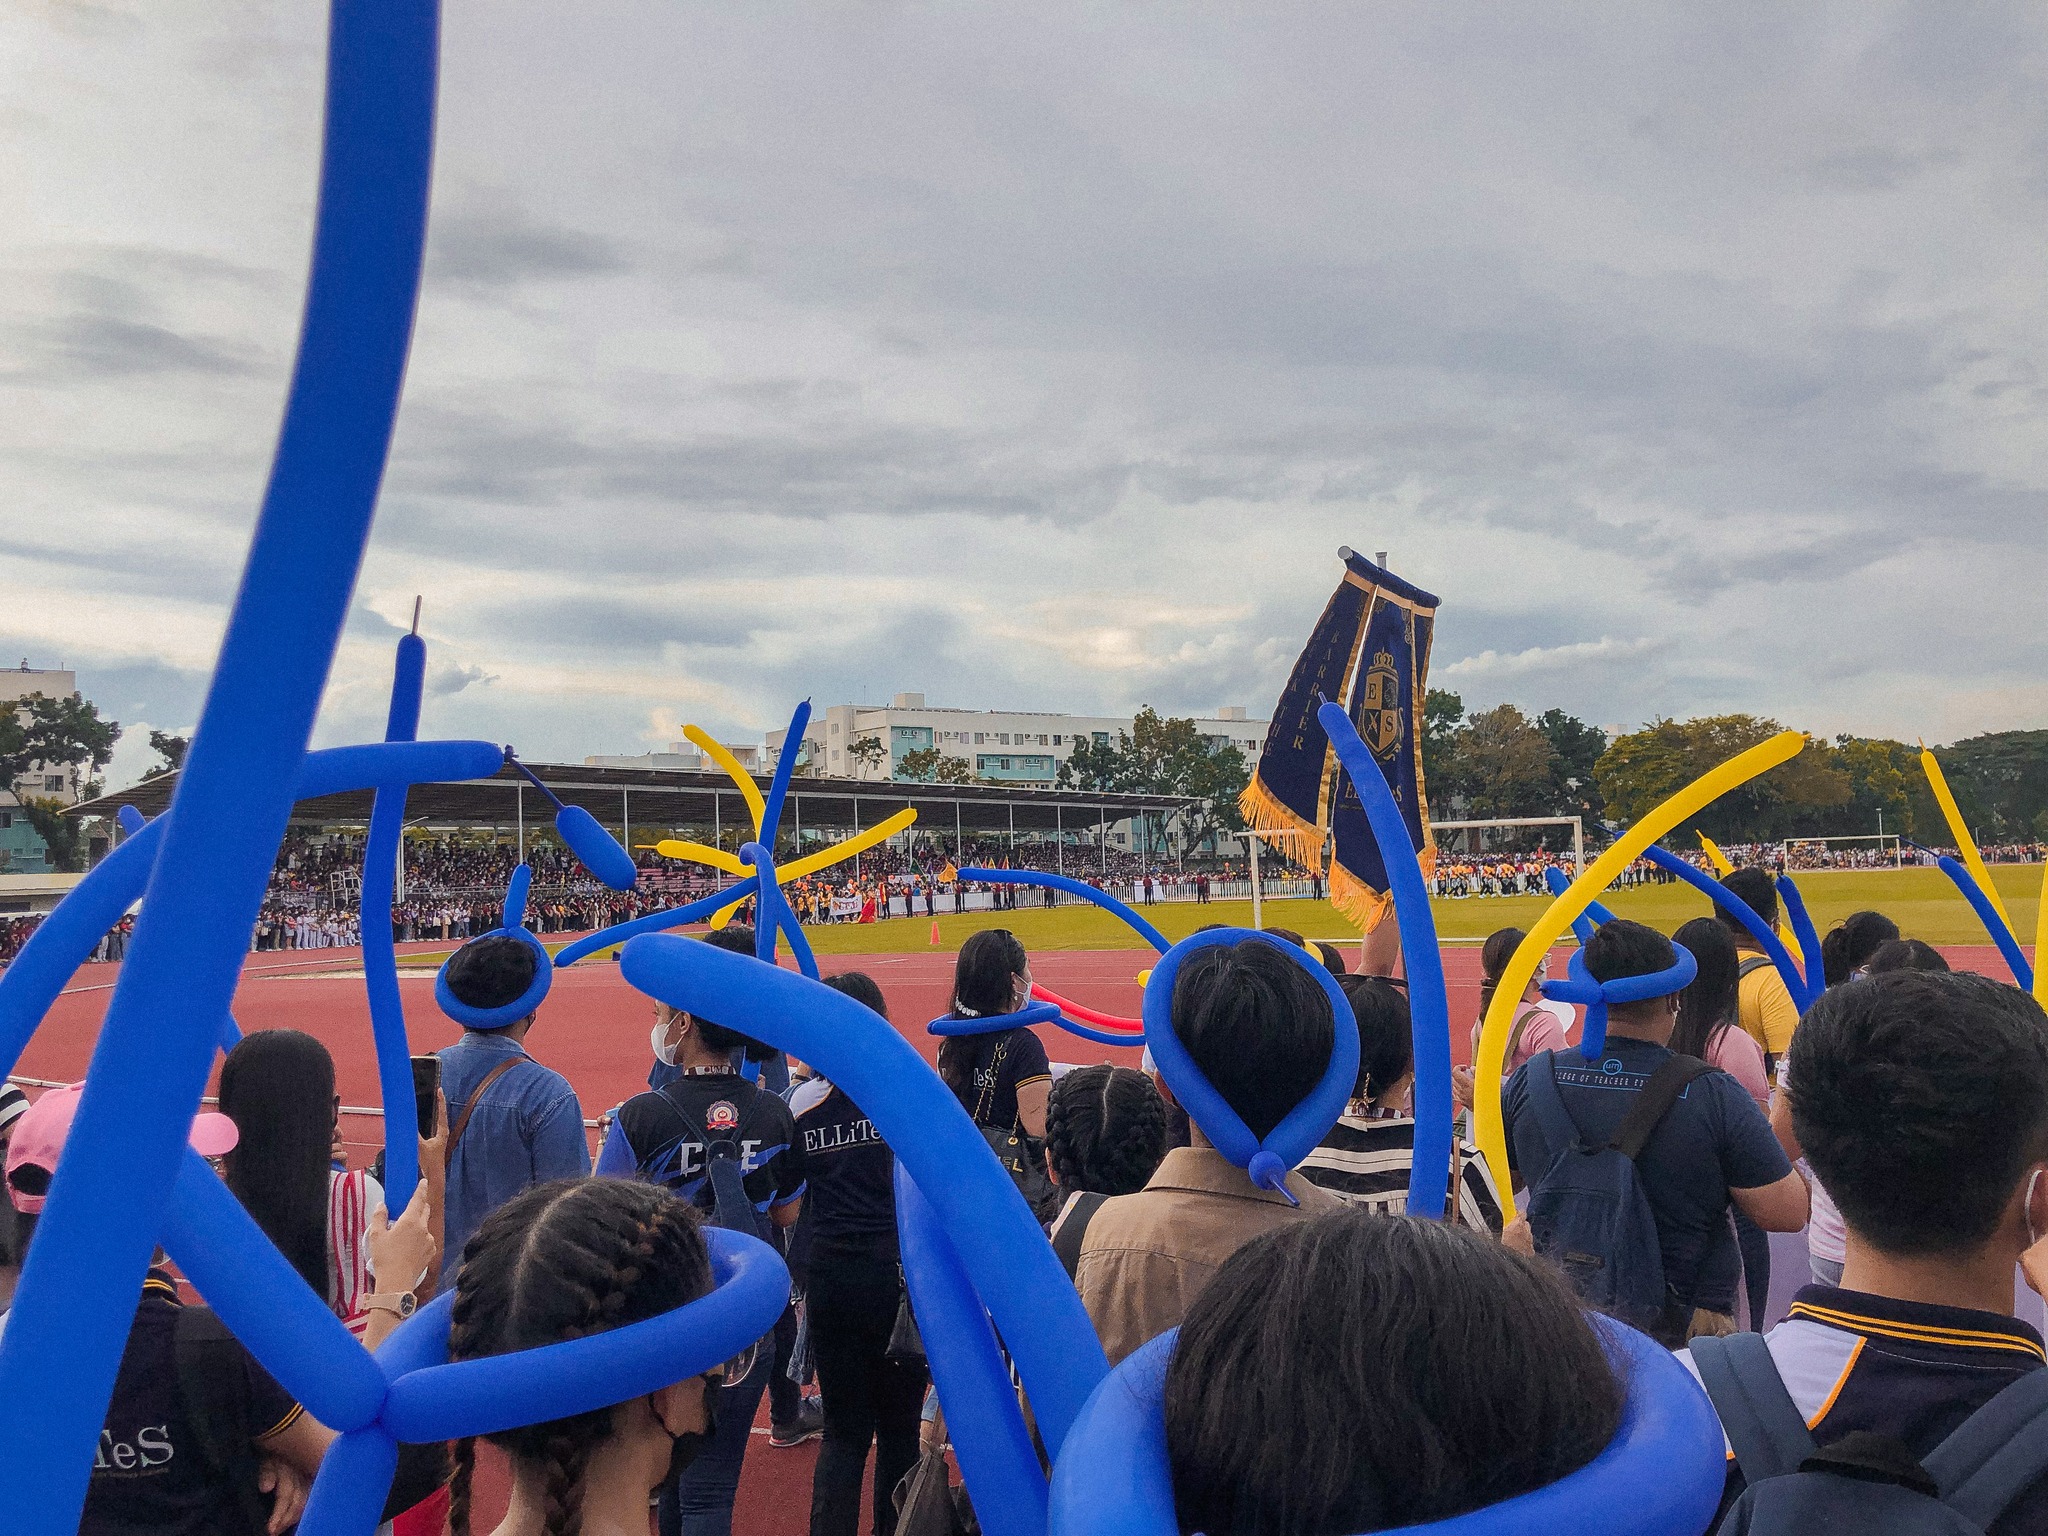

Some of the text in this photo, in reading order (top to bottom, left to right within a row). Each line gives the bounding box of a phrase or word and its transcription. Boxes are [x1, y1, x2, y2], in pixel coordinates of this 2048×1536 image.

[1367, 683, 1377, 700] E
[1385, 715, 1394, 733] S
[803, 1119, 882, 1152] ELLiTe
